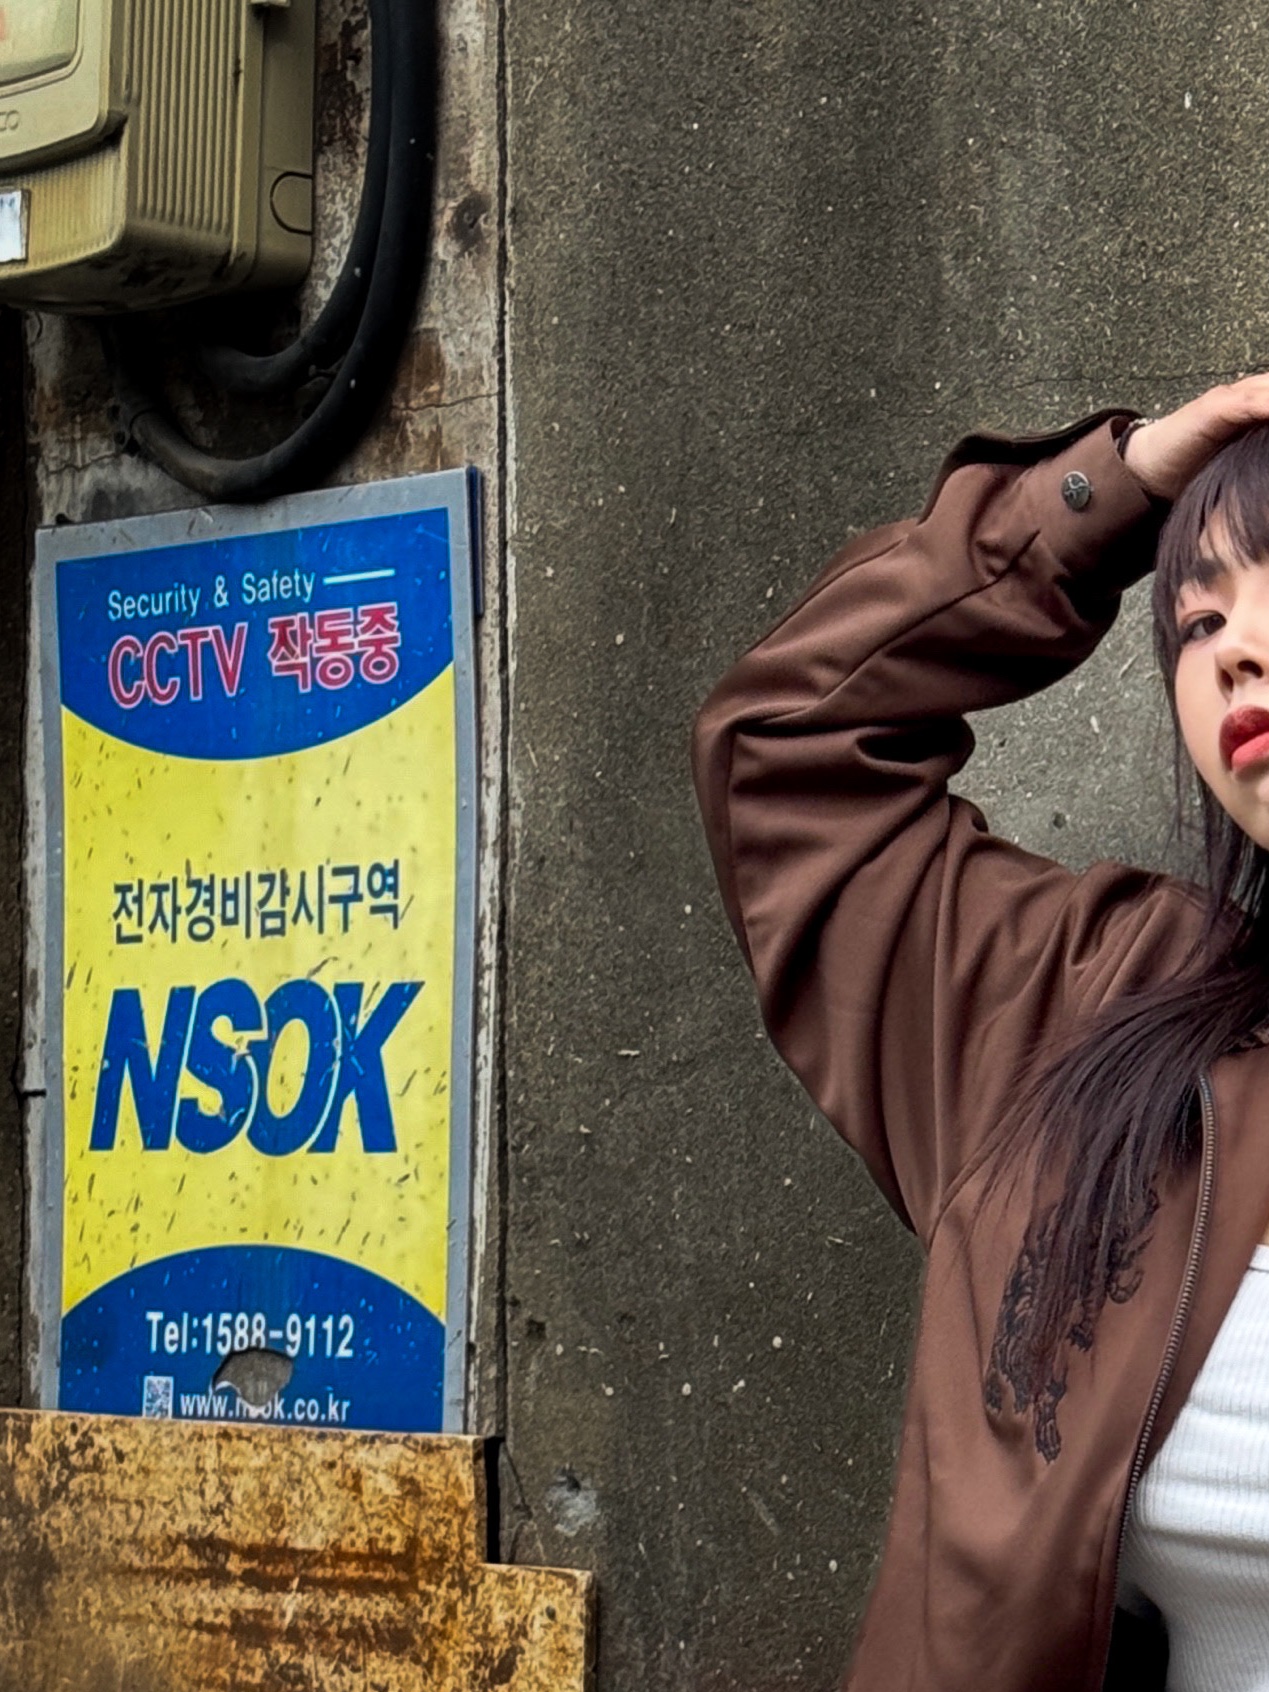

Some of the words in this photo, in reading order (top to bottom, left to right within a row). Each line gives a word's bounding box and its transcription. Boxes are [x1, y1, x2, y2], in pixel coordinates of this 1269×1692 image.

[107, 582, 201, 621] Security
[213, 575, 230, 609] &
[242, 570, 316, 604] Safety
[108, 622, 248, 709] CCTV
[268, 602, 401, 694] 작동중
[112, 859, 401, 945] 전자경비감시구역
[89, 978, 425, 1157] NSOK
